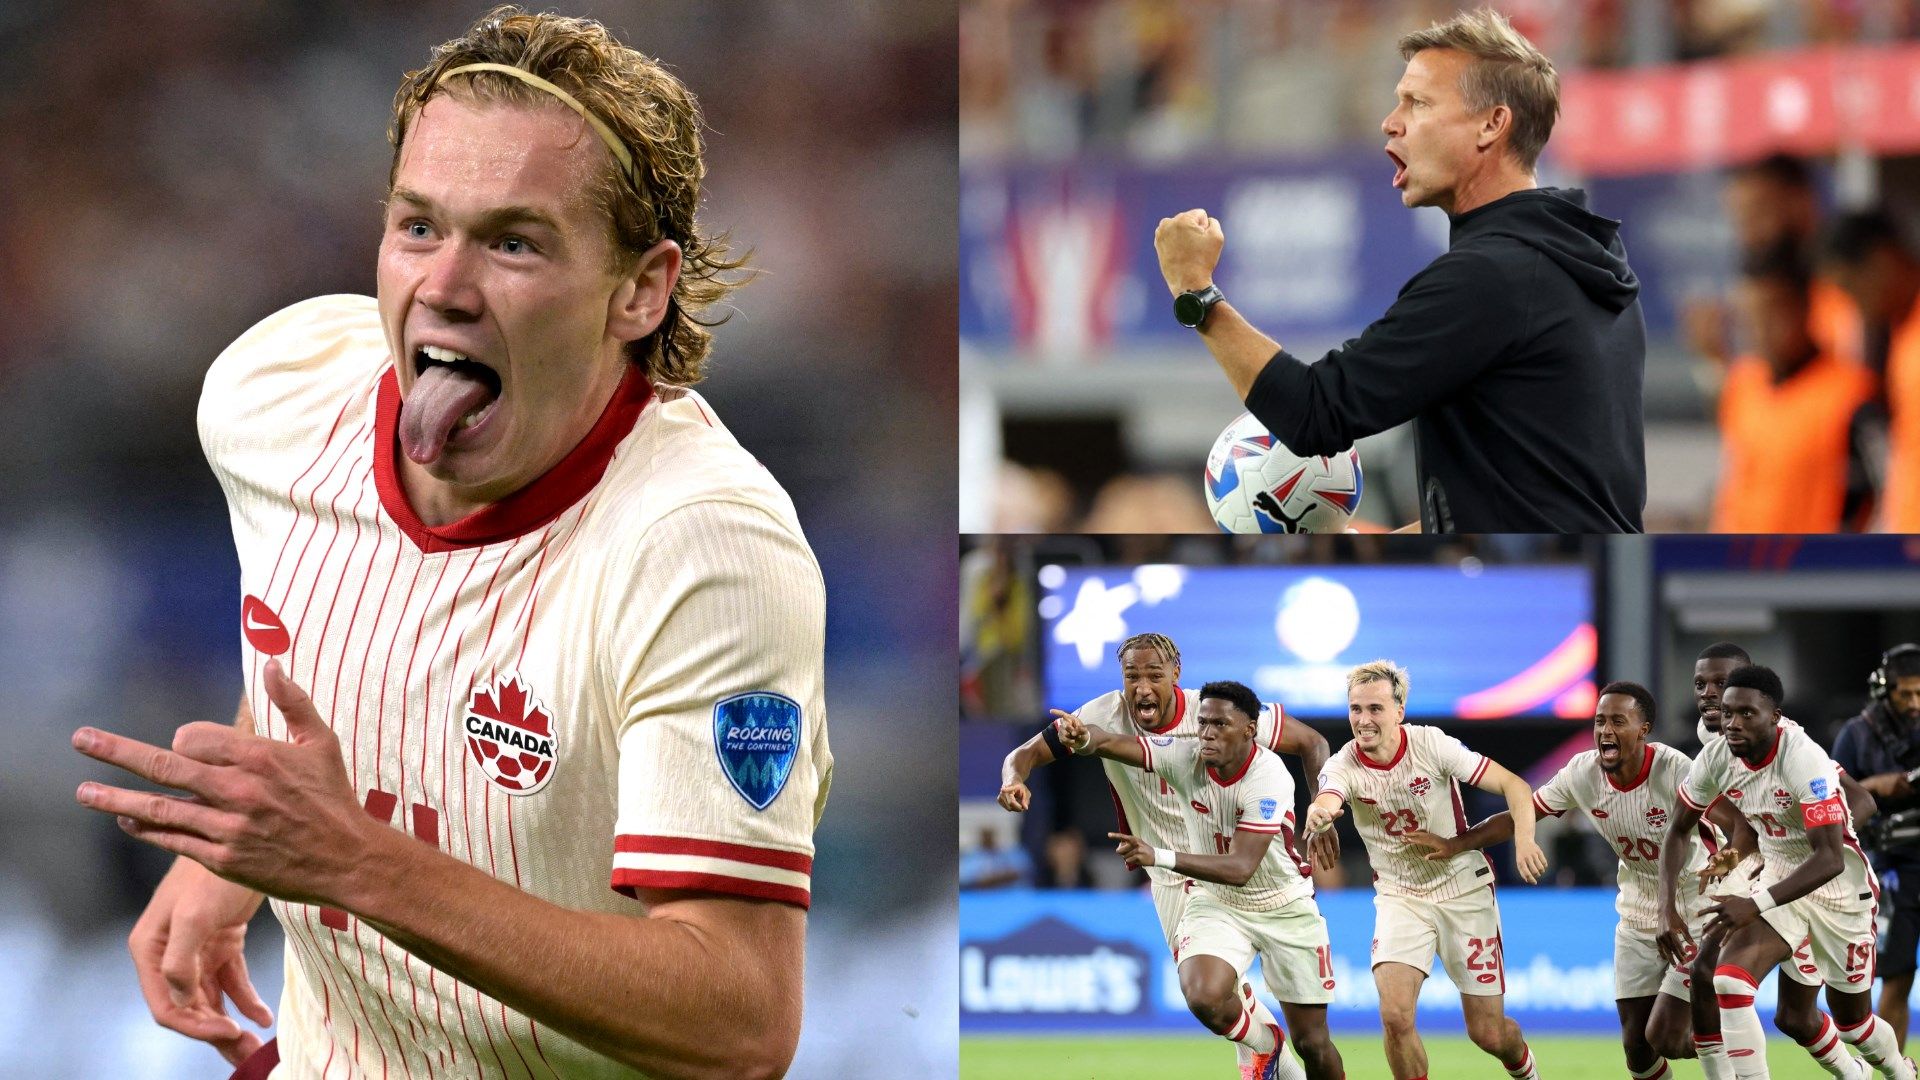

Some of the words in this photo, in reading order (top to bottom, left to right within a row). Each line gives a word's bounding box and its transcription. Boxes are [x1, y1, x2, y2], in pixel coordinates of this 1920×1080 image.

[466, 716, 553, 758] CANADA
[726, 742, 744, 750] THE
[747, 742, 793, 751] CONTINENT
[727, 726, 793, 741] ROCKING
[1380, 809, 1418, 836] 23
[1617, 836, 1660, 861] 20
[1467, 937, 1498, 971] 23
[1846, 941, 1870, 972] 19
